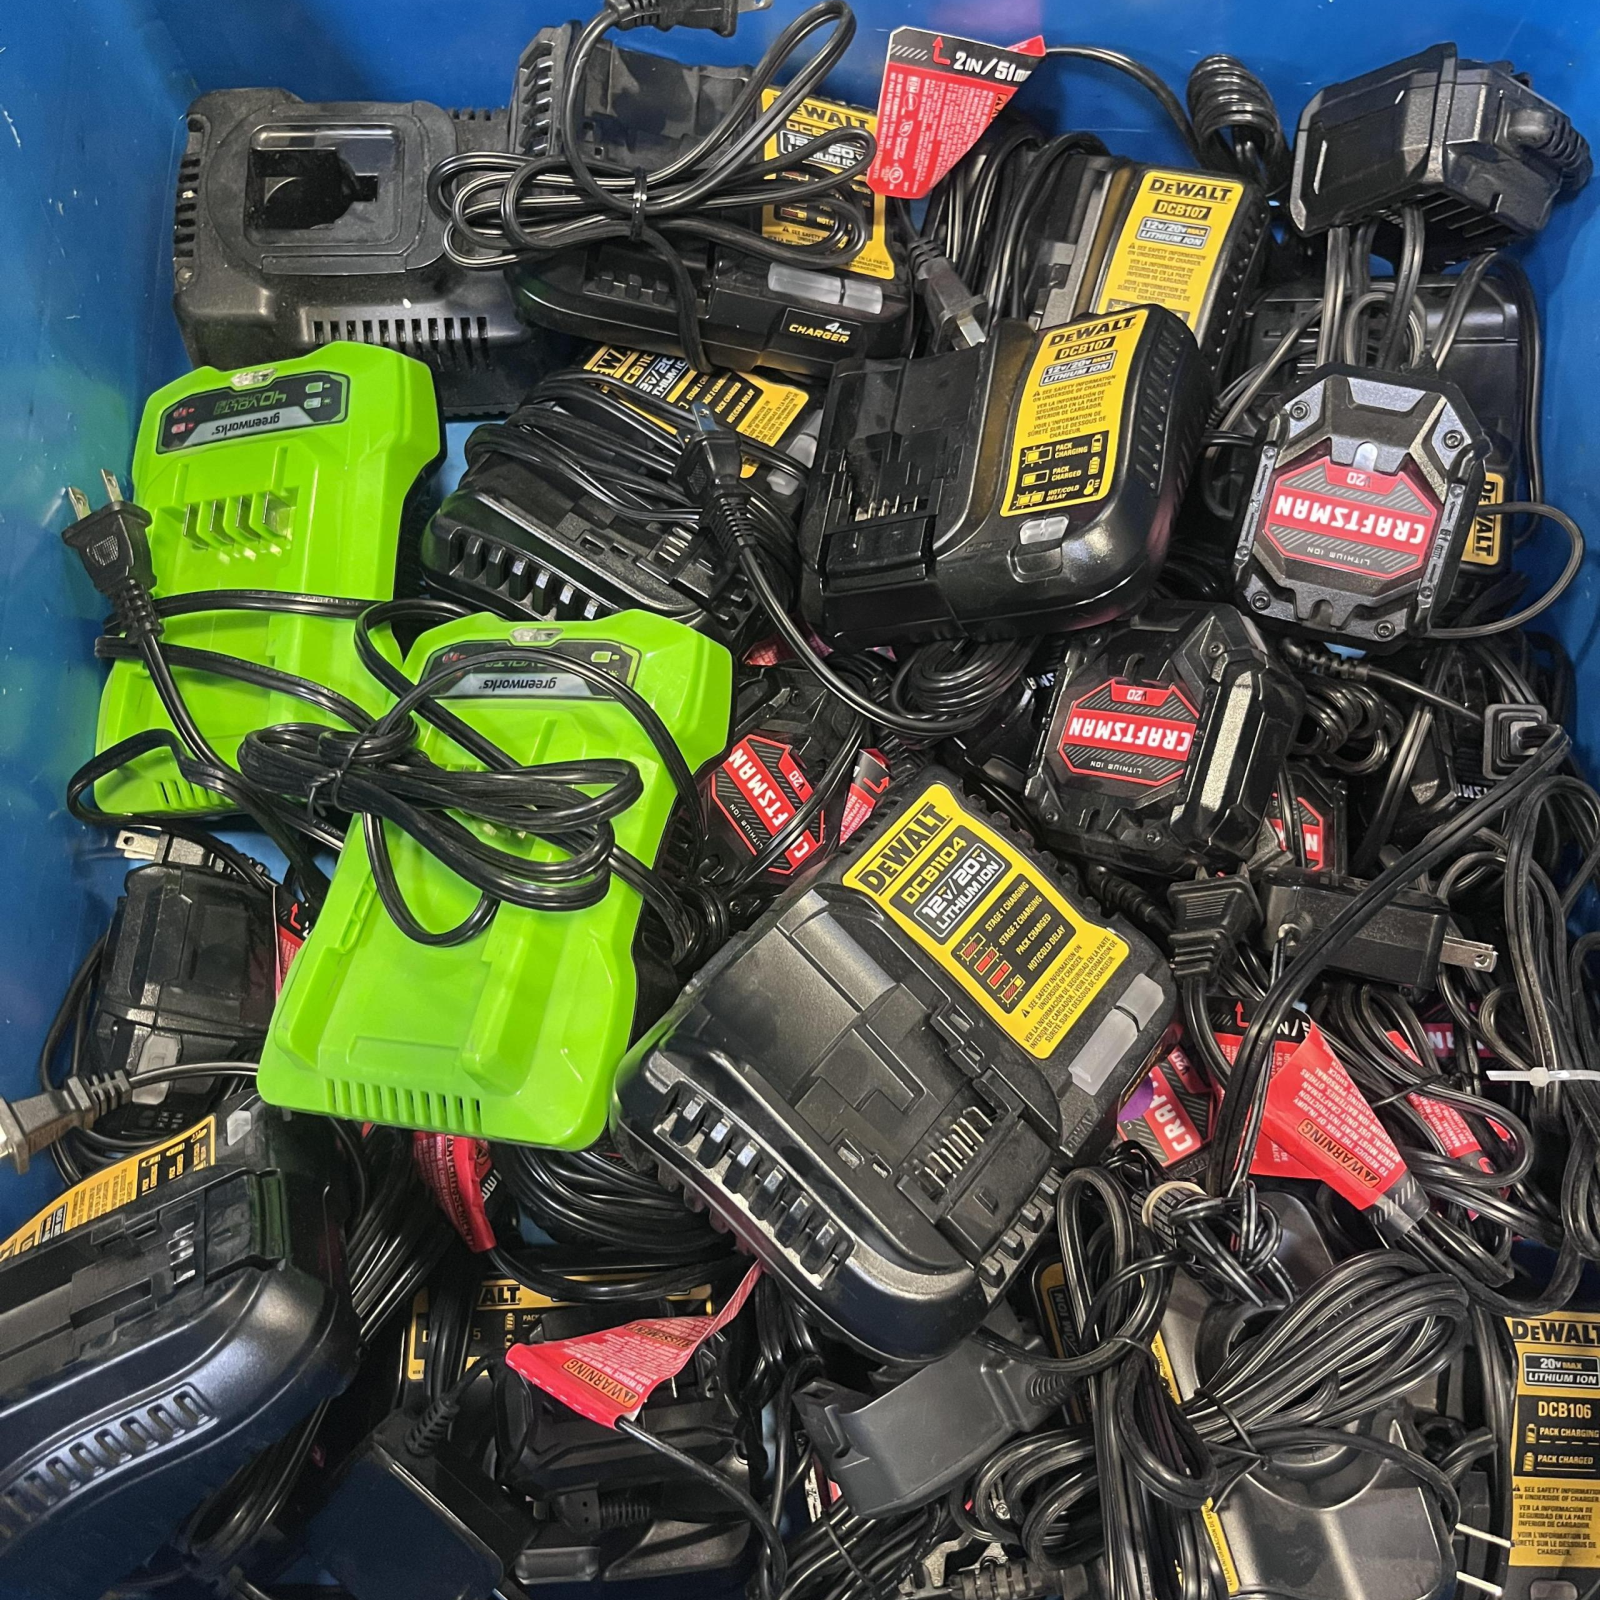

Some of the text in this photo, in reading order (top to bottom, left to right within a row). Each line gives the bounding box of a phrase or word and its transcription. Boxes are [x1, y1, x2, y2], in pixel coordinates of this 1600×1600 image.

[1156, 201, 1207, 218] DCB107
[1140, 230, 1203, 245] LITHIUM ION
[789, 324, 849, 343] CHARGER
[1058, 338, 1111, 358] DCB107
[1043, 362, 1109, 382] LITHIUM ION
[685, 385, 701, 400] STAGE
[1054, 384, 1074, 392] SAFETY
[1075, 374, 1115, 387] INFORMATION
[713, 381, 742, 413] PACK CHARGED
[1042, 389, 1074, 400] UNDERSIDE
[725, 388, 756, 423] HOT/COLD DELAY
[1035, 404, 1067, 415] SEGURIDAD
[1085, 396, 1103, 404] PARTE
[215, 412, 280, 435] greenworks
[1034, 411, 1060, 421] INFERIOR
[1069, 417, 1097, 428] DESSOUS
[1054, 445, 1088, 458] CHARGING
[1055, 442, 1072, 451] PACK
[1050, 469, 1082, 481] CHARGED
[1051, 465, 1069, 474] PACK
[1346, 472, 1371, 488] V20
[1045, 492, 1066, 501] DELAY
[1047, 484, 1079, 496] HOT/COLD
[1275, 495, 1426, 544] CRAFTSMAN
[1475, 481, 1496, 557] DEALT
[1307, 546, 1371, 566] LITHIUM ION
[483, 677, 556, 690] greenworks
[1127, 689, 1147, 701] V20
[1069, 717, 1192, 752] CRAFTSMAN
[1108, 763, 1142, 774] LITHIUM
[730, 803, 764, 849] LITHIUM ION
[900, 834, 967, 905] DCB1104
[935, 860, 999, 930] LITHIUM ION
[984, 910, 1003, 932] STAGE
[1002, 881, 1029, 911] CHARGING
[998, 924, 1017, 945] STAGE
[1015, 894, 1043, 925] CHARGING
[1015, 912, 1052, 955] PACK CHARGED
[1027, 924, 1066, 971] HOT/COLD DELAY
[1027, 944, 1082, 1010] SEE SAFETY INFORMATION ON
[1037, 954, 1083, 1010] UNDERSIDE OF CHARGER.
[1023, 935, 1110, 1043] VER LA INFORMACIÓN DE SEGURIDAD EN LA PARTE
[1029, 1025, 1049, 1049] INFERIOR
[1046, 1019, 1054, 1028] DE
[1073, 979, 1086, 993] VOIR
[1082, 945, 1112, 981] L'INFORMATION
[1108, 939, 1117, 948] DE
[1058, 1012, 1070, 1025] SUR
[1067, 1006, 1075, 1014] LE
[1071, 985, 1091, 1009] DESSOUS
[1088, 979, 1096, 987] DE
[1300, 1067, 1325, 1090] OTHERS
[1313, 1067, 1347, 1096] PERSONAL
[1326, 1067, 1349, 1087] SHOCK
[1301, 1080, 1341, 1115] CRAFTSMAN
[1298, 1088, 1395, 1170] USER MUST READ INSTRUCTION
[1315, 1114, 1327, 1126] OF
[1339, 1111, 1358, 1128] ONLY
[1324, 1122, 1342, 1138] RISK
[1357, 1125, 1372, 1139] USE
[1299, 1120, 1365, 1177] WARNING
[1340, 1135, 1355, 1149] THE
[1352, 1145, 1380, 1169] REDUCE
[1377, 1165, 1389, 1177] TO
[563, 1359, 627, 1397] WARNING
[1528, 1372, 1595, 1383] LITHIUM ION
[1538, 1400, 1590, 1418] DCB106
[1540, 1427, 1599, 1437] PACK CHARGING
[1538, 1454, 1593, 1464] PACK CHARGED
